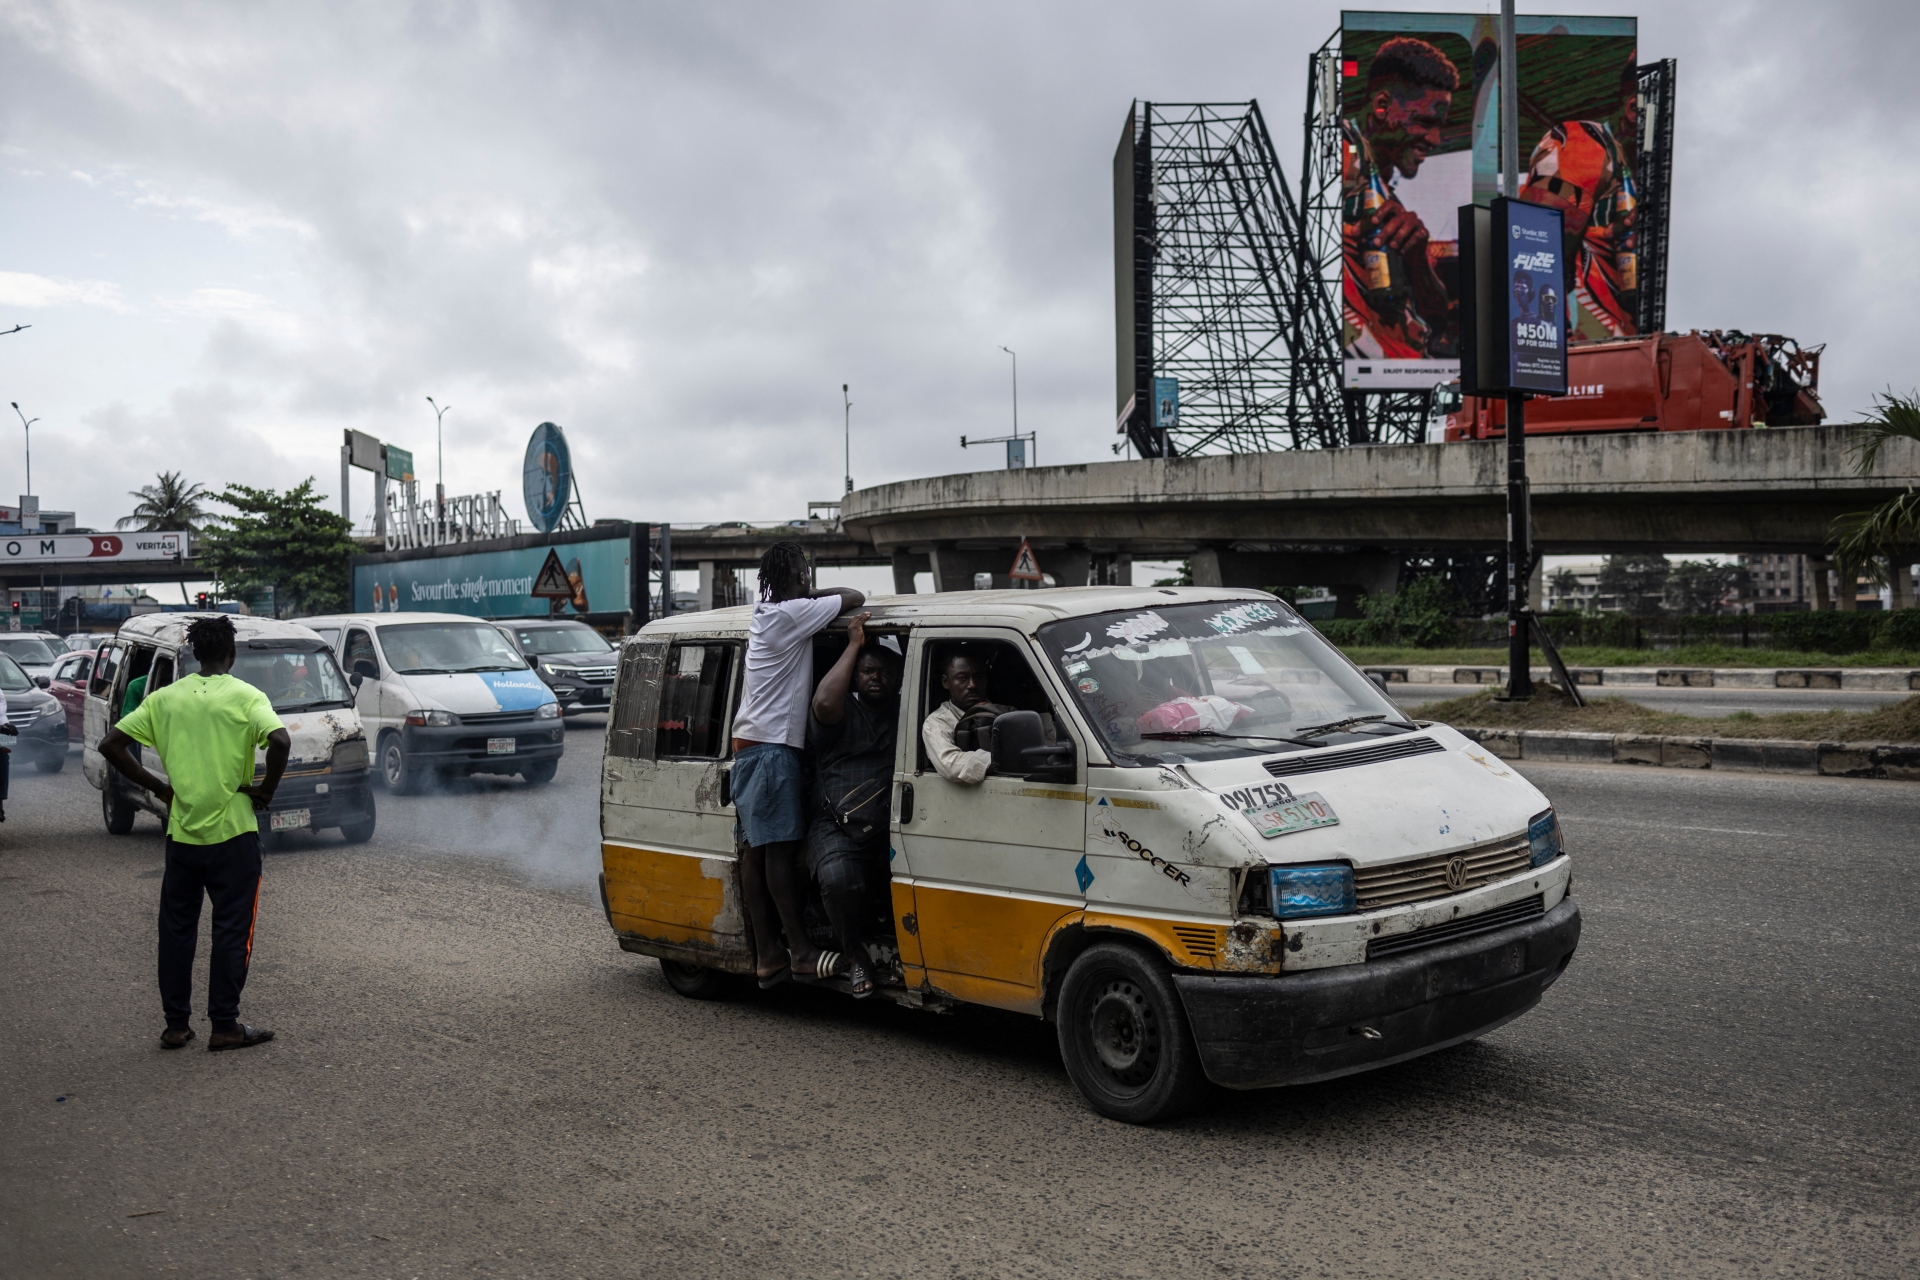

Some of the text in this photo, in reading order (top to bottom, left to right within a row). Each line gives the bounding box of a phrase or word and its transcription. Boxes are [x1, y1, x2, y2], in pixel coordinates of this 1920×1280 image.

[1521, 227, 1537, 236] Stanbic
[1513, 251, 1555, 271] FUZE
[1526, 339, 1537, 347] FOR
[1538, 341, 1557, 349] GRABS
[384, 489, 502, 552] SINGLETON
[136, 541, 176, 550] VERITASI
[411, 575, 533, 604] Savour the single moment
[493, 680, 543, 691] Hollandia
[1266, 797, 1298, 809] LAGOS
